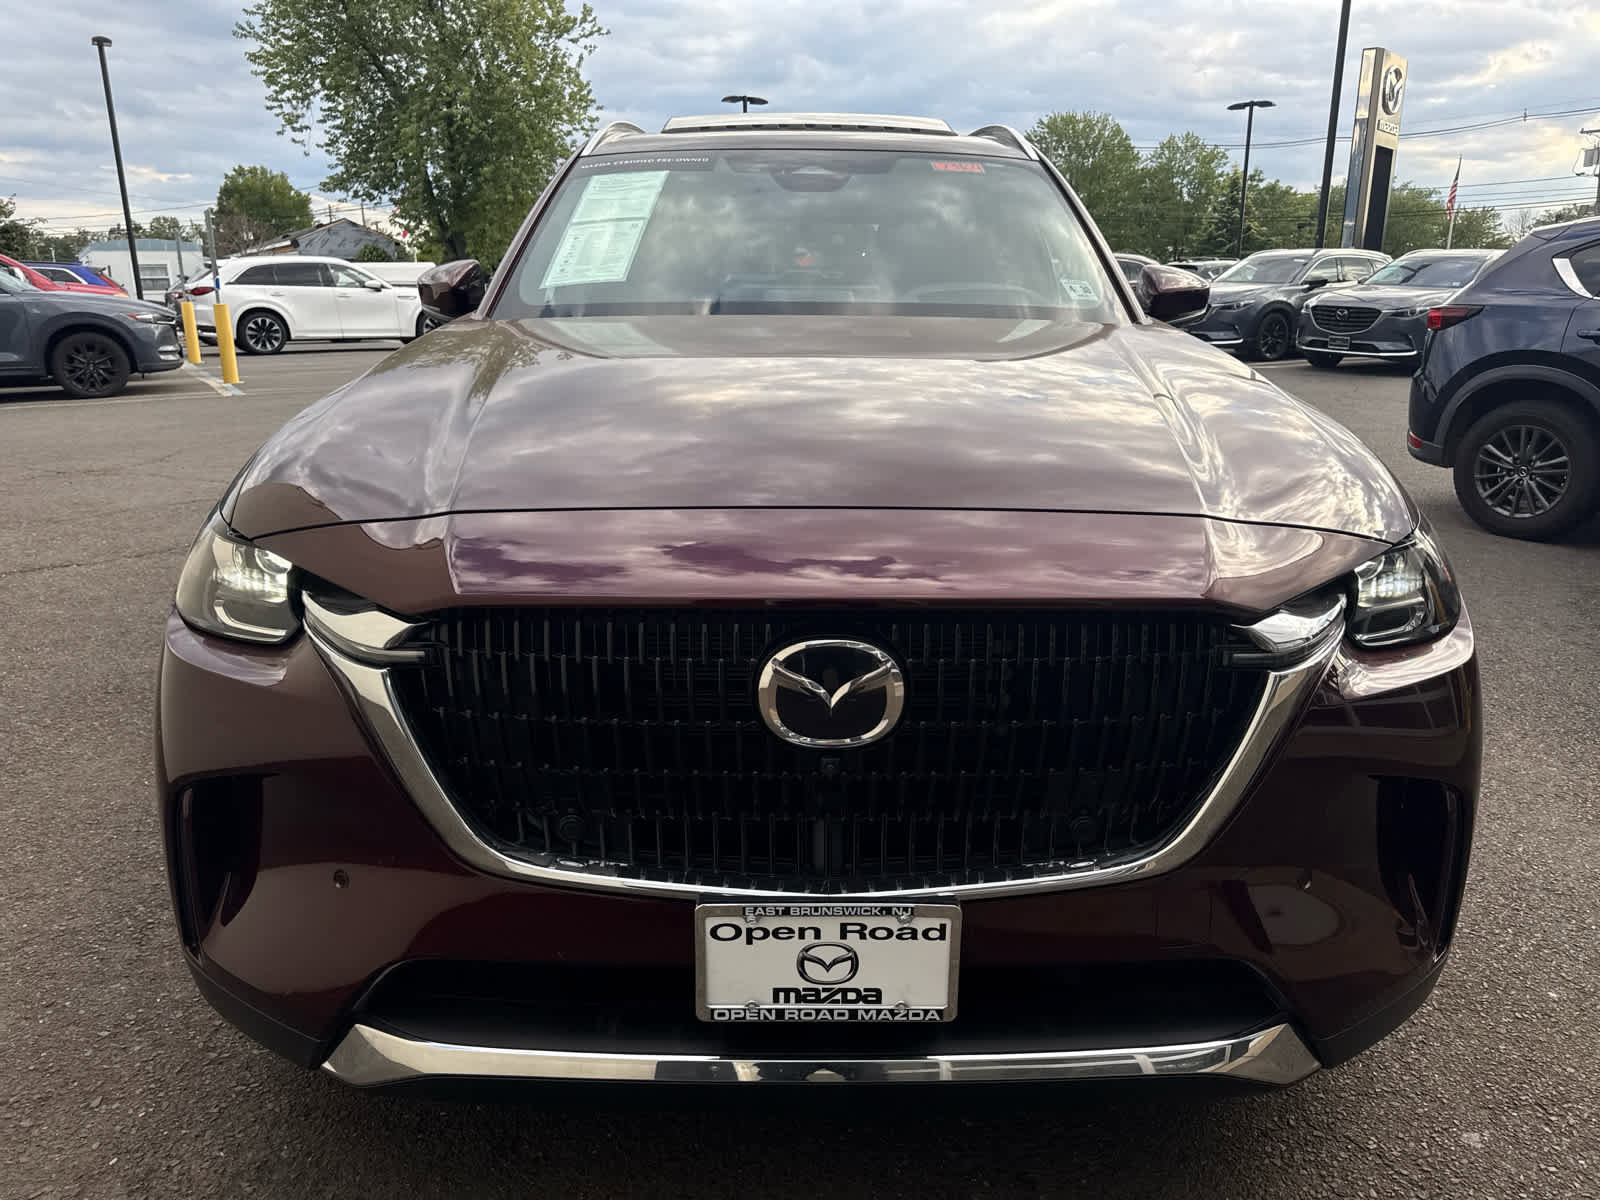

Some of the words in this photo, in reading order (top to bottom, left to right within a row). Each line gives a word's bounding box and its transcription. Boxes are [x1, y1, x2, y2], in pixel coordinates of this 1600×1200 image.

[745, 907, 785, 916] EAST
[892, 907, 912, 917] NJ
[709, 923, 822, 945] Open
[839, 922, 947, 941] Road
[772, 987, 882, 1005] mazda
[713, 1009, 776, 1021] OPEN
[784, 1009, 849, 1021] ROAD
[857, 1009, 941, 1021] MAZDA
